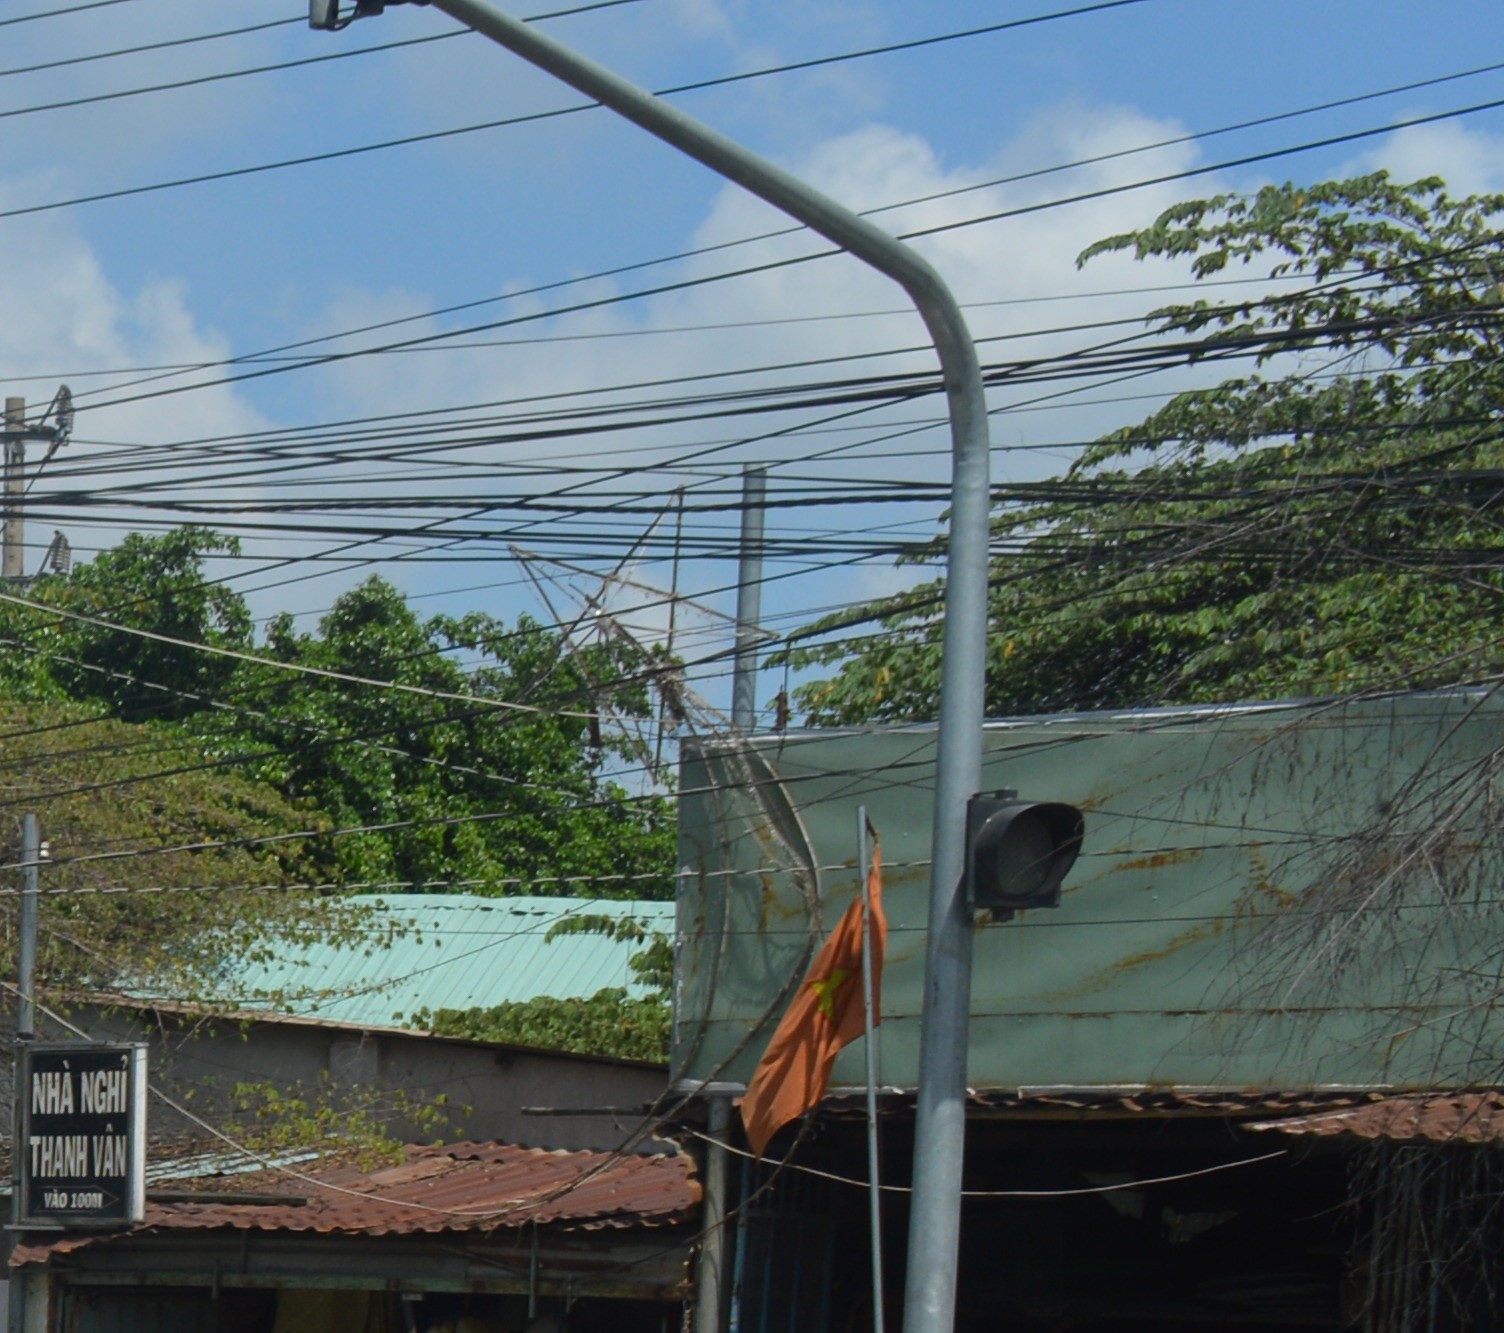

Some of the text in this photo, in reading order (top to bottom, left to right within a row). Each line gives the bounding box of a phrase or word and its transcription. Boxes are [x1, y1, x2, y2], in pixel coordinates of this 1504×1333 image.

[32, 1054, 128, 1115] NHÀ NGHỈ
[30, 1122, 126, 1178] THANH VÂN
[44, 1188, 69, 1209] VÀO
